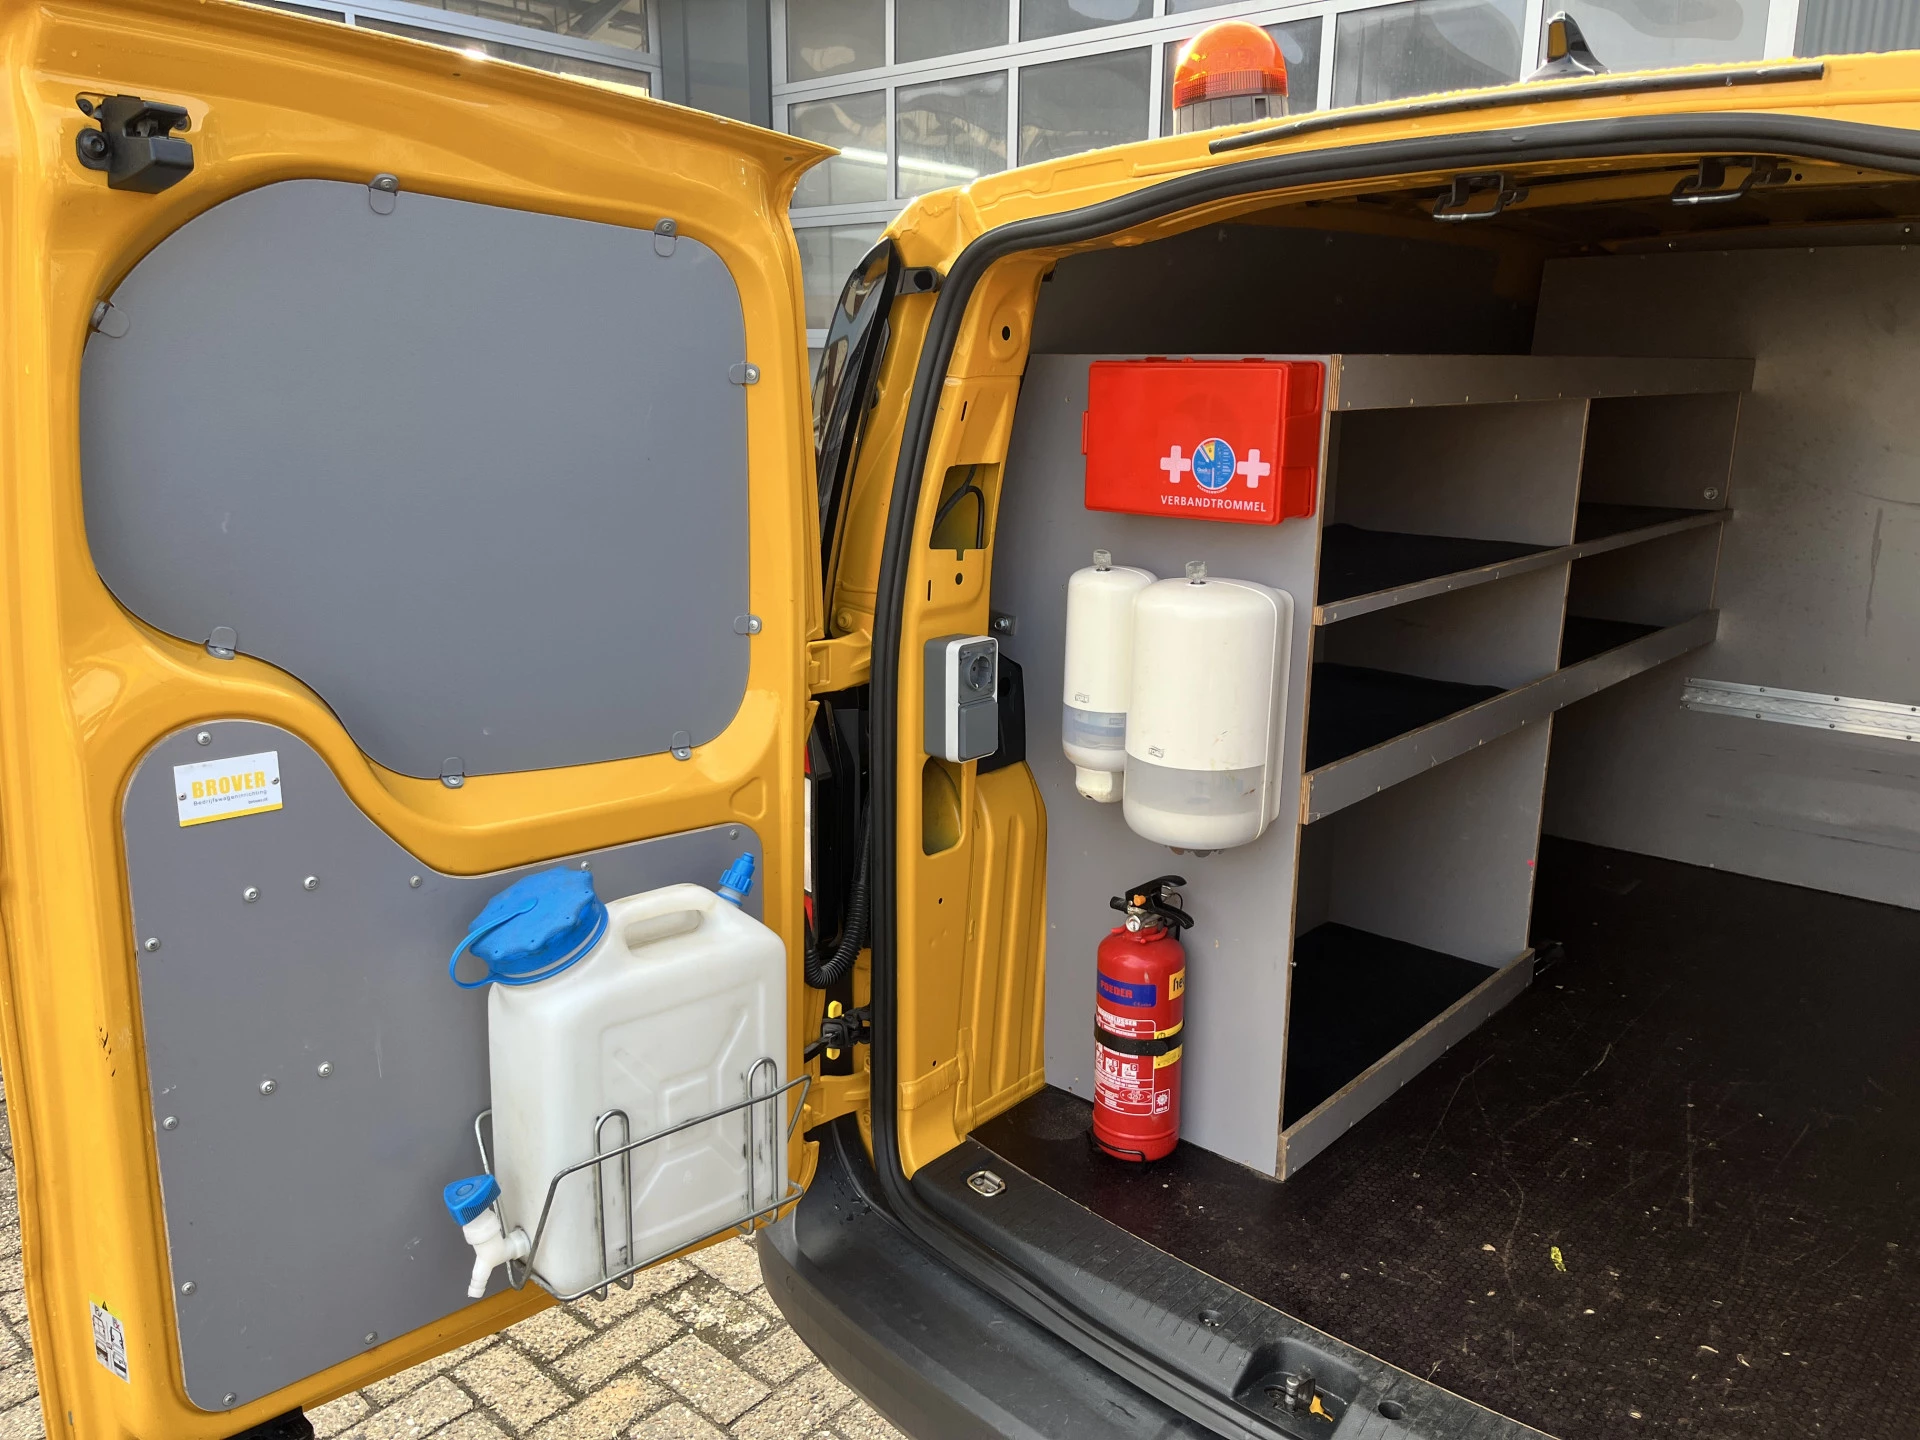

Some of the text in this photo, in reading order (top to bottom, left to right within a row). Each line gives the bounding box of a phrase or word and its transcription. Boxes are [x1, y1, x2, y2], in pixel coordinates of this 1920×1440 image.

[1161, 495, 1266, 512] VERBANDTROMMEL
[192, 771, 266, 799] BROVER
[193, 790, 267, 806] Bedrijfswageninrichting
[1101, 980, 1133, 999] POEDER
[1173, 978, 1184, 991] he
